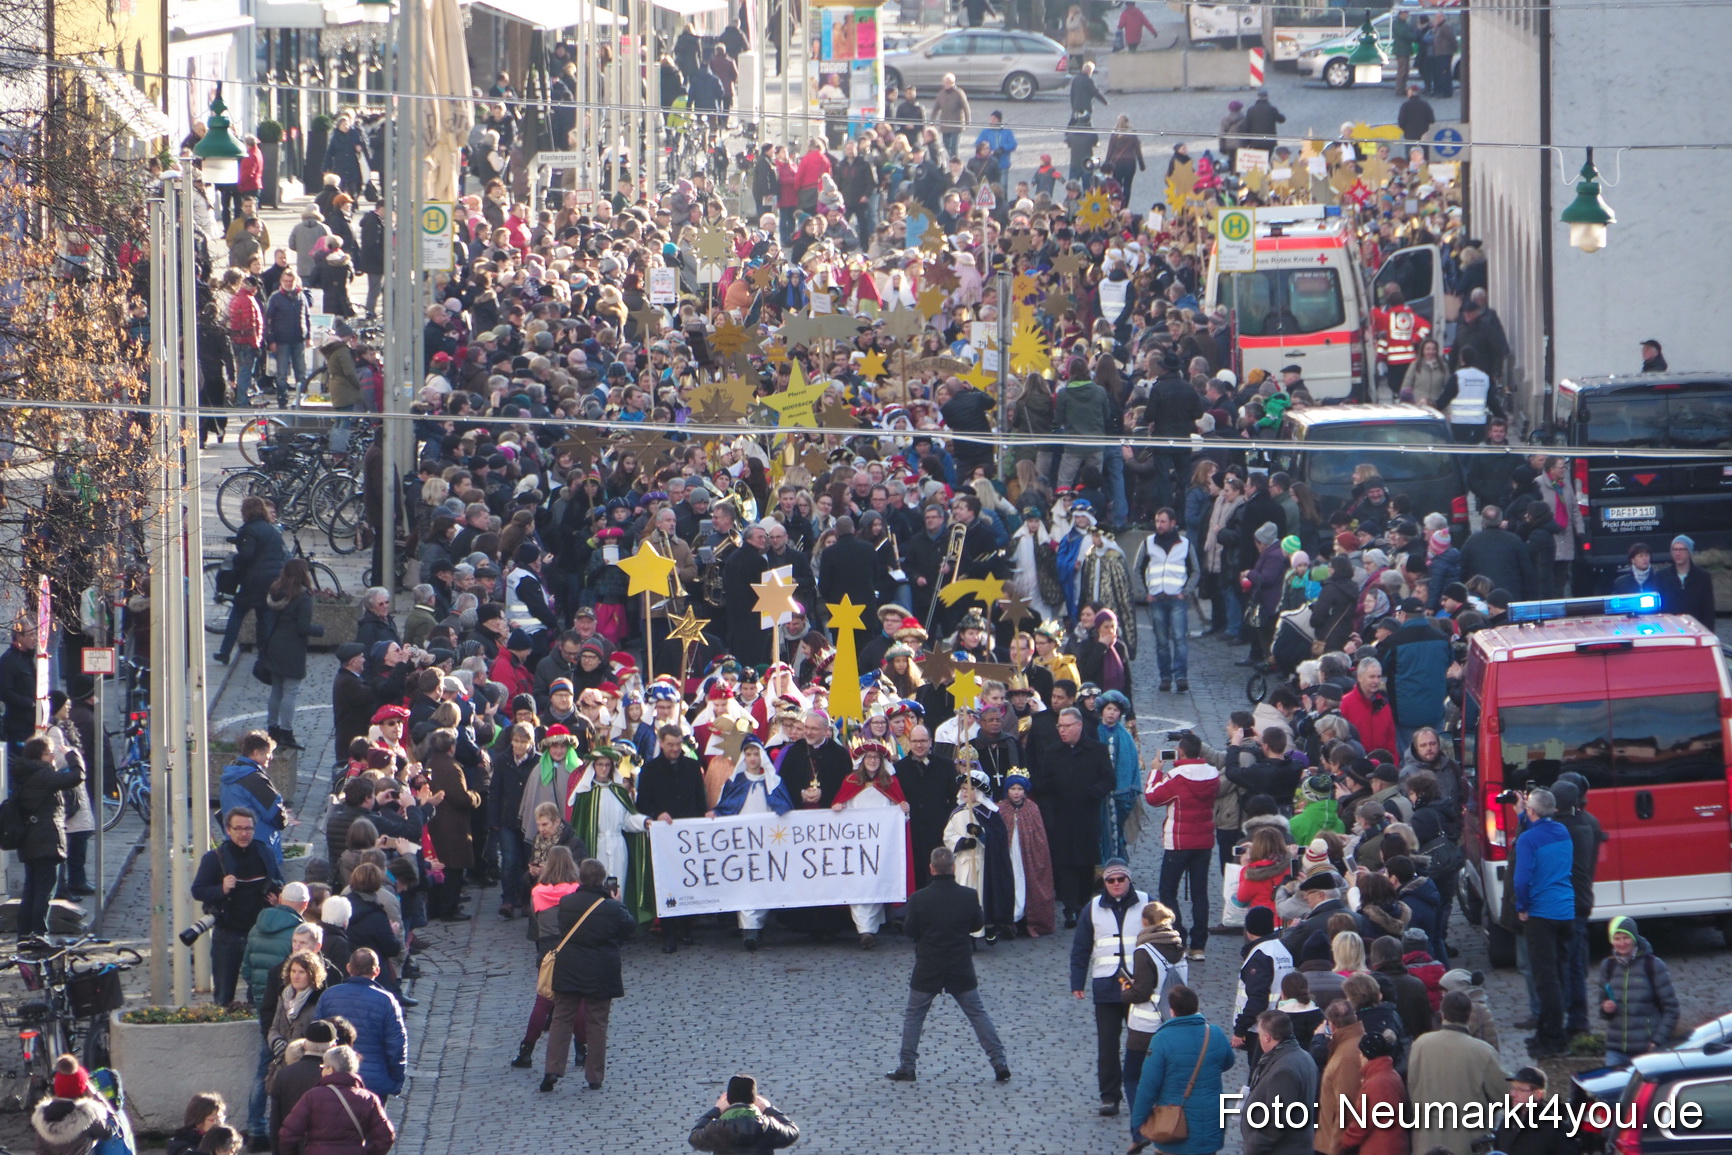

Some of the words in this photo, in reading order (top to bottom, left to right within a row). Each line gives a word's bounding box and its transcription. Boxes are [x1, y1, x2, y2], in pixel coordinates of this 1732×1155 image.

[540, 154, 577, 162] Klostergasse
[427, 213, 439, 229] H
[1229, 219, 1242, 234] H
[782, 400, 813, 411] MOOSBACH
[1621, 519, 1660, 527] Automobile
[677, 825, 764, 855] SEGEN
[792, 822, 880, 845] BRINGEN
[682, 850, 789, 888] SEGEN
[801, 843, 880, 880] SEIN
